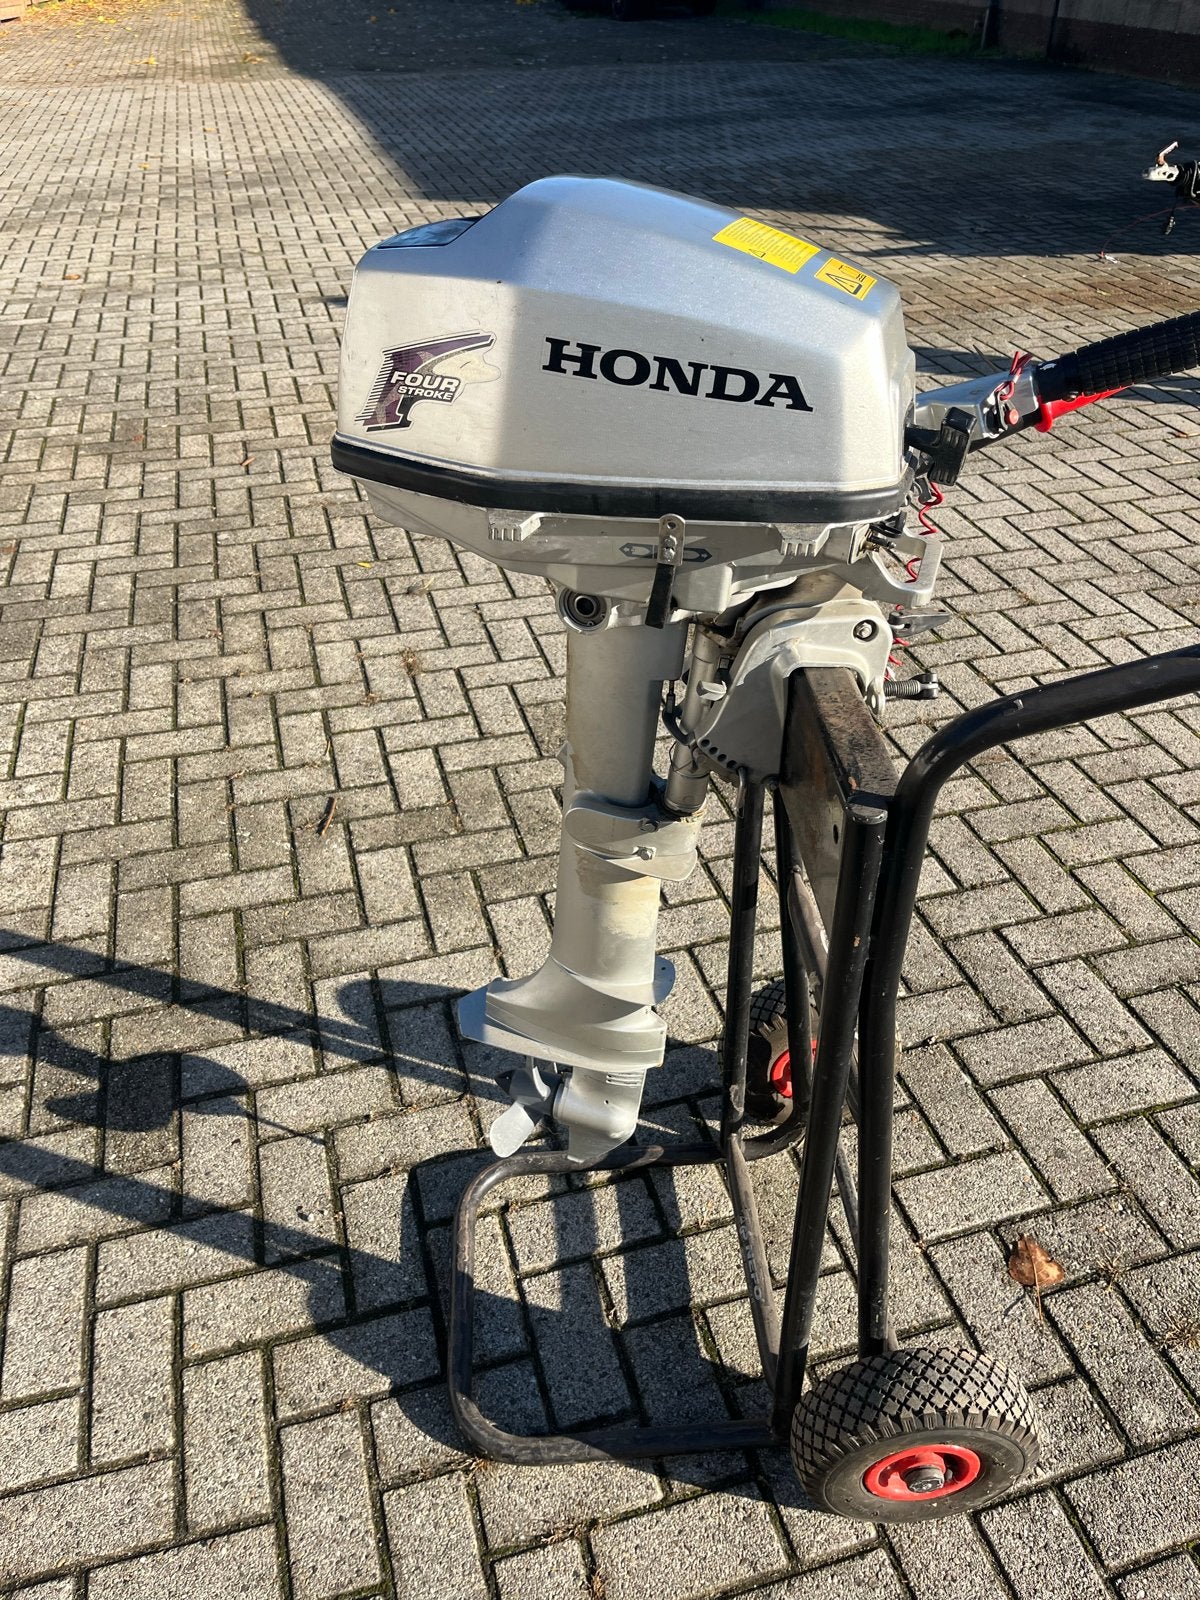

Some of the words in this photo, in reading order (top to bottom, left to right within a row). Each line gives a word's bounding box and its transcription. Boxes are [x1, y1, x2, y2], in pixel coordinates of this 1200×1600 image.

[390, 371, 460, 392] FOUR
[542, 337, 813, 412] HONDA
[398, 386, 454, 400] STROKE
